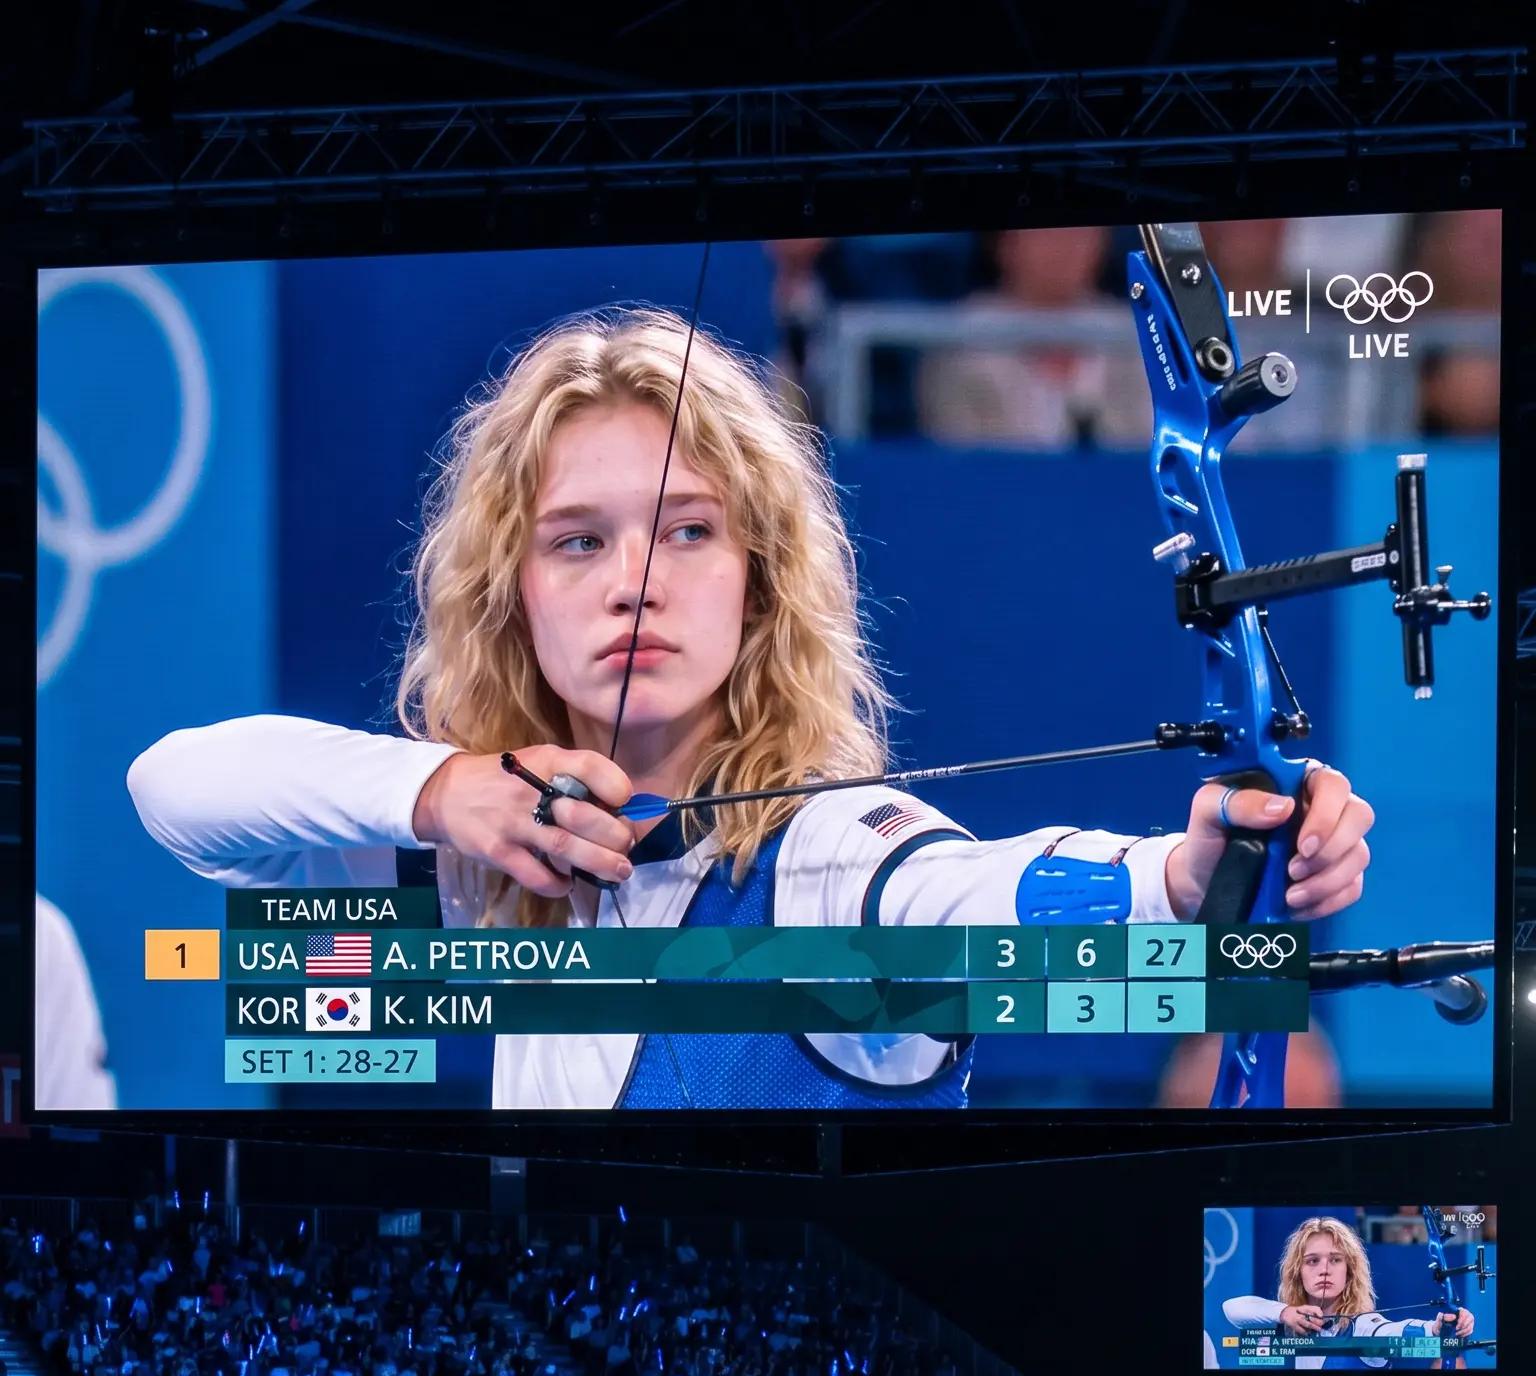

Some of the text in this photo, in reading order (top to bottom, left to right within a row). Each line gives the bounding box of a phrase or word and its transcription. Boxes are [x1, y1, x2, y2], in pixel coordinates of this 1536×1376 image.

[1227, 289, 1292, 318] LIVE
[1349, 333, 1410, 359] LIVE
[261, 898, 398, 921] TEAM USA
[175, 943, 187, 969] 1
[239, 941, 591, 971] USA A. PETROVA
[997, 938, 1187, 968] 3 6 27
[238, 995, 492, 1025] KOR K. KIM
[996, 994, 1176, 1023] 2 3 5
[242, 1049, 418, 1074] SET 1: 28-27
